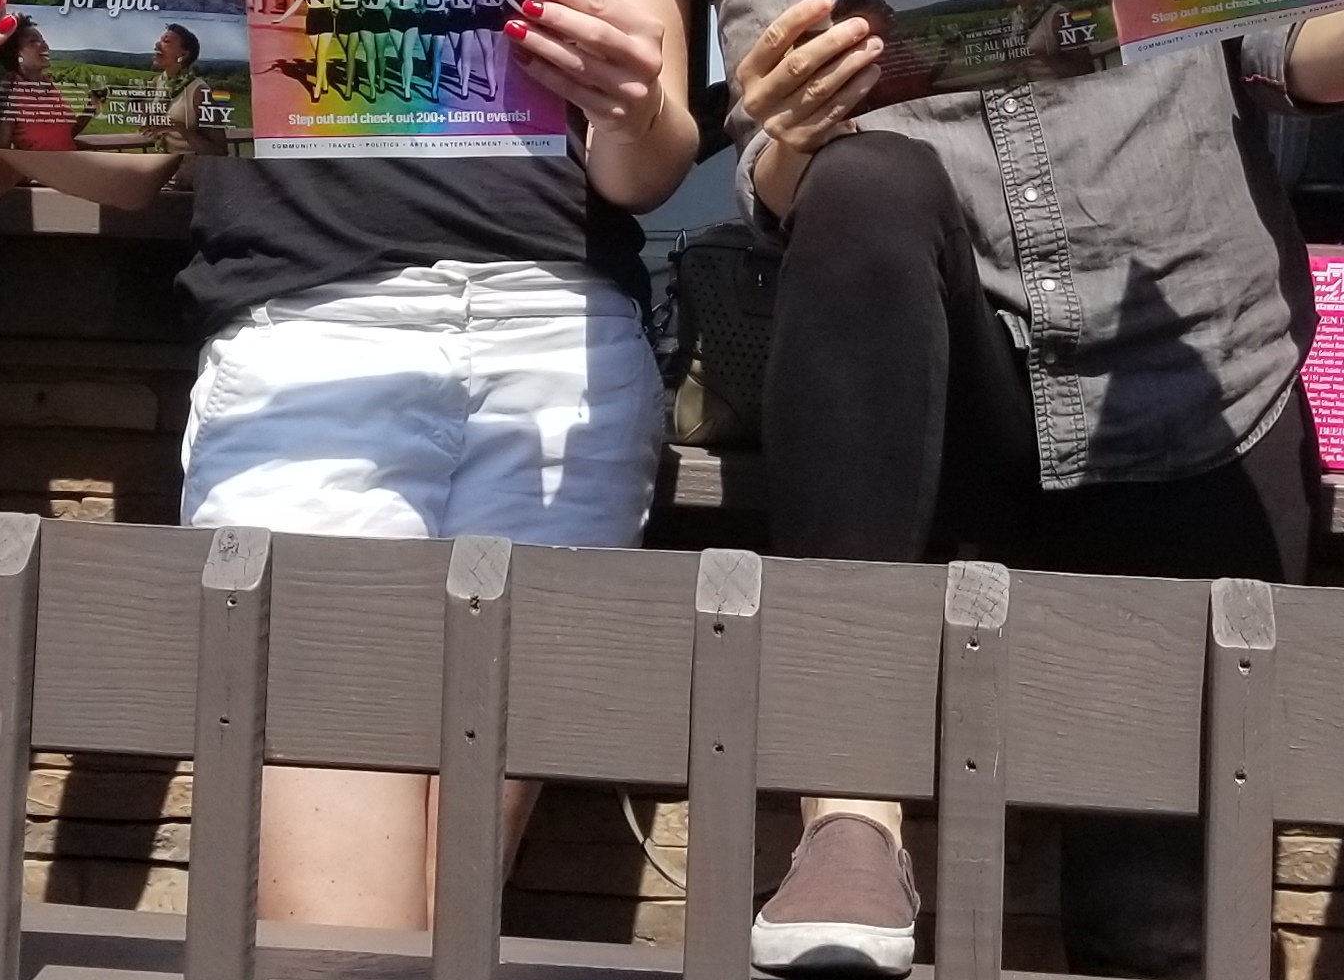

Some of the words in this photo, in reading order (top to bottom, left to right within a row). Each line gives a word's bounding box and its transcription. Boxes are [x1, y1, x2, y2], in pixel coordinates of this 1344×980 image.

[109, 101, 126, 112] IT'S
[127, 102, 142, 113] ALL
[108, 114, 123, 124] IT'S
[126, 116, 147, 126] only
[198, 106, 235, 122] NY
[288, 113, 314, 127] Step
[316, 114, 334, 126] out
[336, 112, 358, 125] and
[360, 112, 395, 125] check
[396, 112, 414, 124] out
[416, 112, 446, 124] 200+
[447, 111, 485, 125] LGBTQ
[486, 110, 531, 123] events!
[439, 140, 503, 148] ENTERTAINMENT
